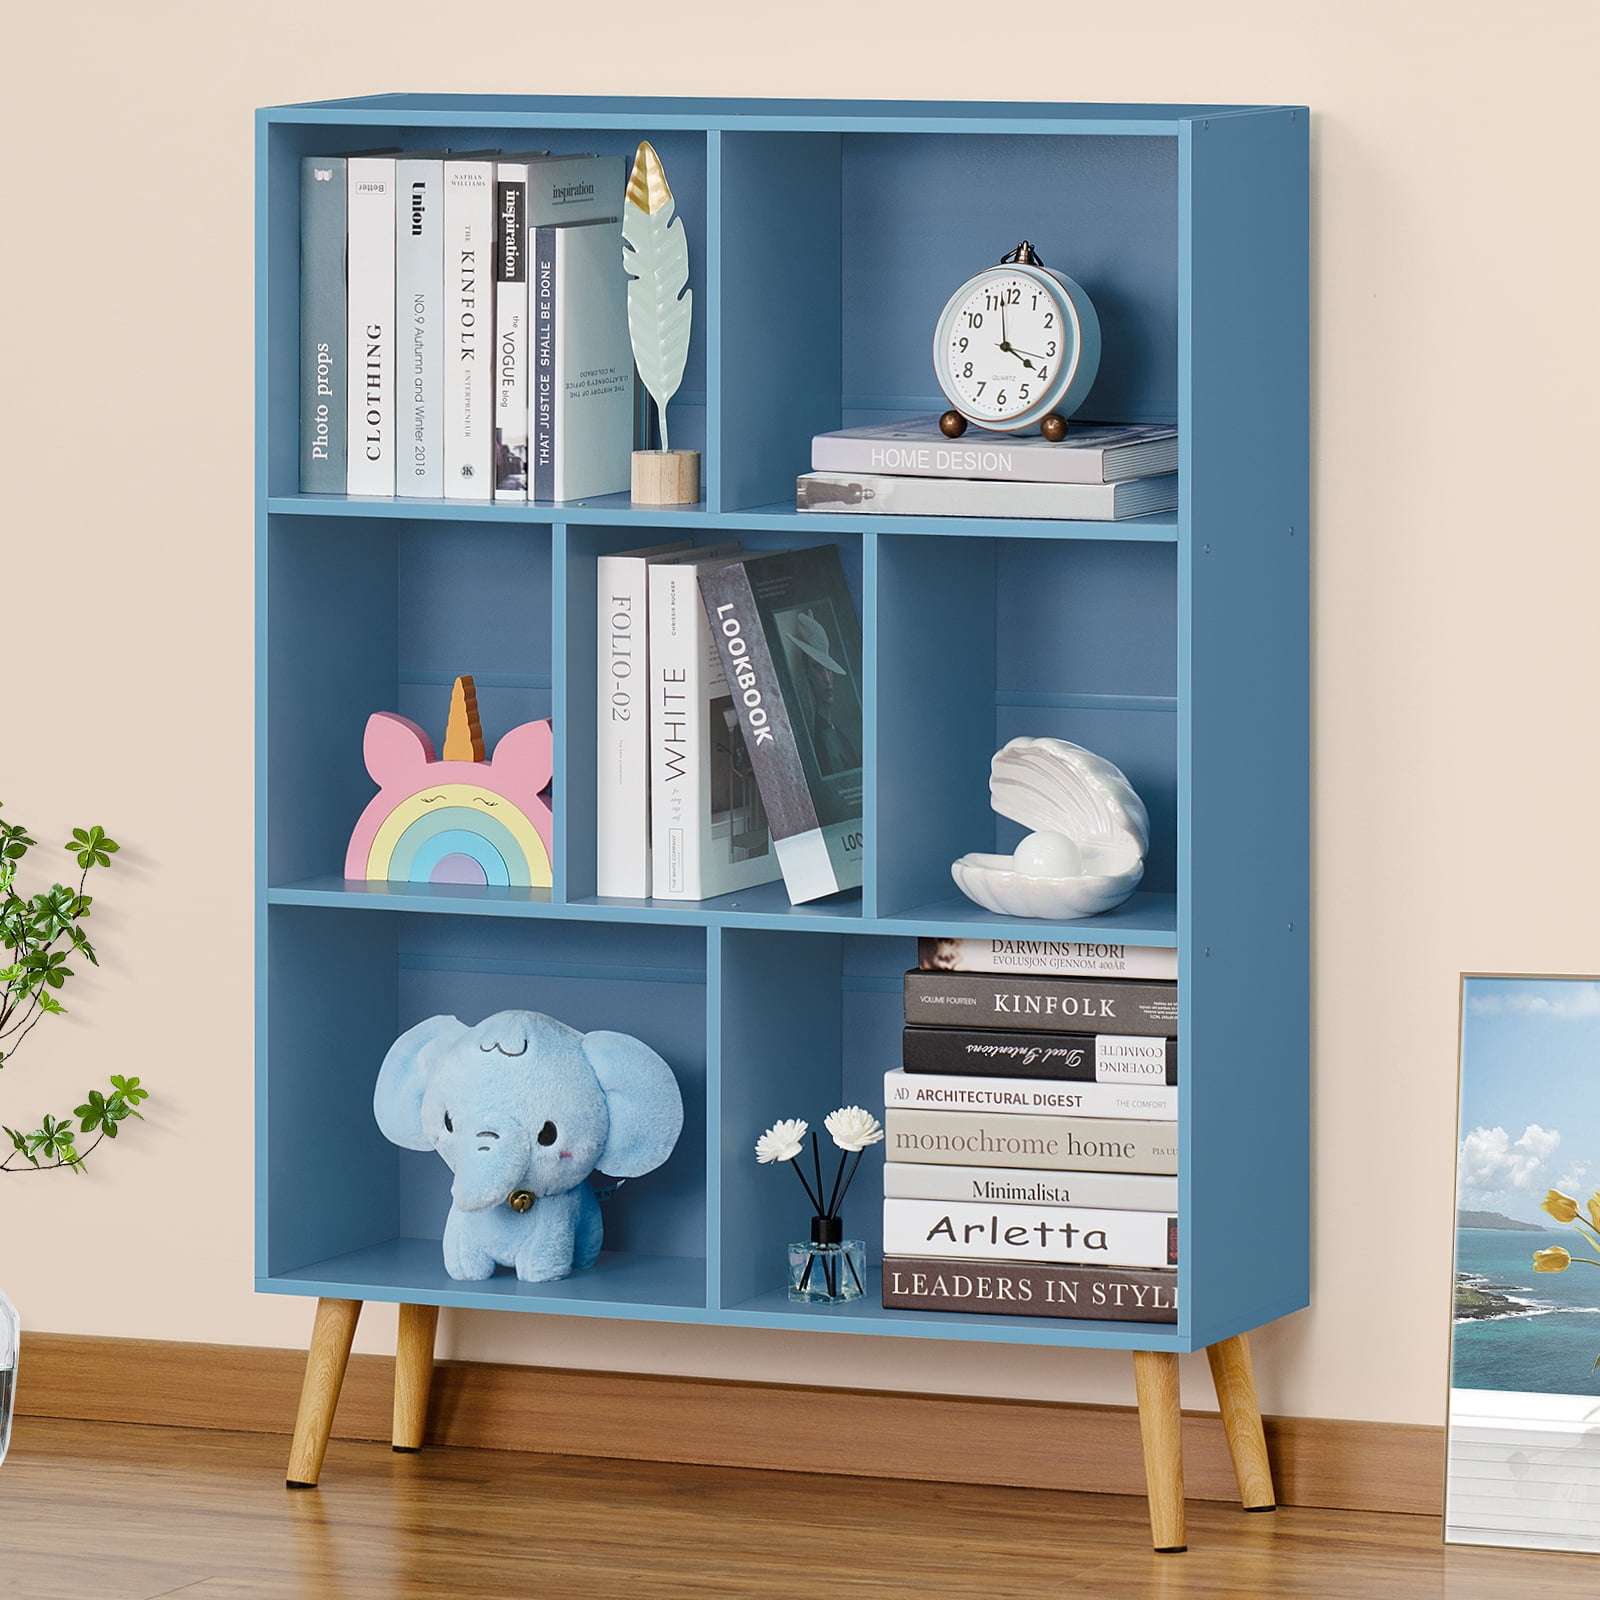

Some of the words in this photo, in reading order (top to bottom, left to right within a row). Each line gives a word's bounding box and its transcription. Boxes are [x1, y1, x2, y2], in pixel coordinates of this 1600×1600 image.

[359, 184, 384, 192] Better
[552, 181, 594, 201] inspiration
[412, 182, 426, 236] Union
[502, 190, 520, 278] inspiration
[541, 261, 551, 298] DONE
[461, 251, 475, 361] KINFOLK
[986, 296, 998, 311] 11
[1006, 288, 1021, 305] 12
[1032, 296, 1038, 311] 1
[414, 294, 425, 325] NO.9
[541, 302, 550, 319] BE
[1044, 312, 1054, 328] 2
[512, 315, 520, 328] the
[968, 313, 983, 328] 10
[414, 327, 425, 375] Autumn
[540, 324, 550, 366] SHALL
[959, 337, 968, 353] 9
[1046, 341, 1056, 357] 3
[502, 331, 515, 387] VOGUE
[317, 343, 333, 397] props
[580, 368, 608, 378] COLORADO
[963, 362, 973, 378] 8
[1038, 366, 1048, 381] 4
[366, 324, 381, 461] CLOTHING
[414, 377, 425, 403] and
[500, 390, 509, 408] blog
[977, 382, 986, 397] 7
[997, 389, 1006, 404] 6
[1018, 384, 1029, 400] 5
[540, 374, 550, 429] JUSTICE
[312, 404, 328, 460] Photo
[414, 405, 425, 442] Winter
[540, 433, 549, 466] THAT
[872, 448, 930, 470] HOME
[414, 446, 425, 476] 2018
[611, 595, 632, 722] FOLIO-02
[716, 603, 774, 746] LOOKBOOK
[664, 668, 687, 782] WHITE
[992, 939, 1070, 957] DARWINS
[1074, 943, 1126, 959] TEORI
[993, 956, 1047, 968] EVOLUSJON
[1050, 958, 1096, 970] GJENNOM
[920, 996, 944, 1004] VOLUME
[946, 997, 976, 1005] FOURTEEN
[994, 994, 1116, 1018] KINFOLK
[1041, 1048, 1085, 1068] Duel
[1100, 1045, 1164, 1058] COMMUTE
[1099, 1062, 1164, 1074] COVERING
[894, 1088, 909, 1100] AD
[916, 1088, 1029, 1106] ARCHITECTURAL
[1033, 1094, 1082, 1108] DIGEST
[1116, 1100, 1130, 1108] THE
[1132, 1100, 1167, 1109] COMFORT
[896, 1129, 1058, 1155] monochrome
[1067, 1132, 1136, 1158] home
[972, 1180, 1070, 1202] Minimalista
[926, 1216, 1108, 1250] Arletta
[891, 1272, 1032, 1301] LEADERS
[1045, 1280, 1079, 1304] IN
